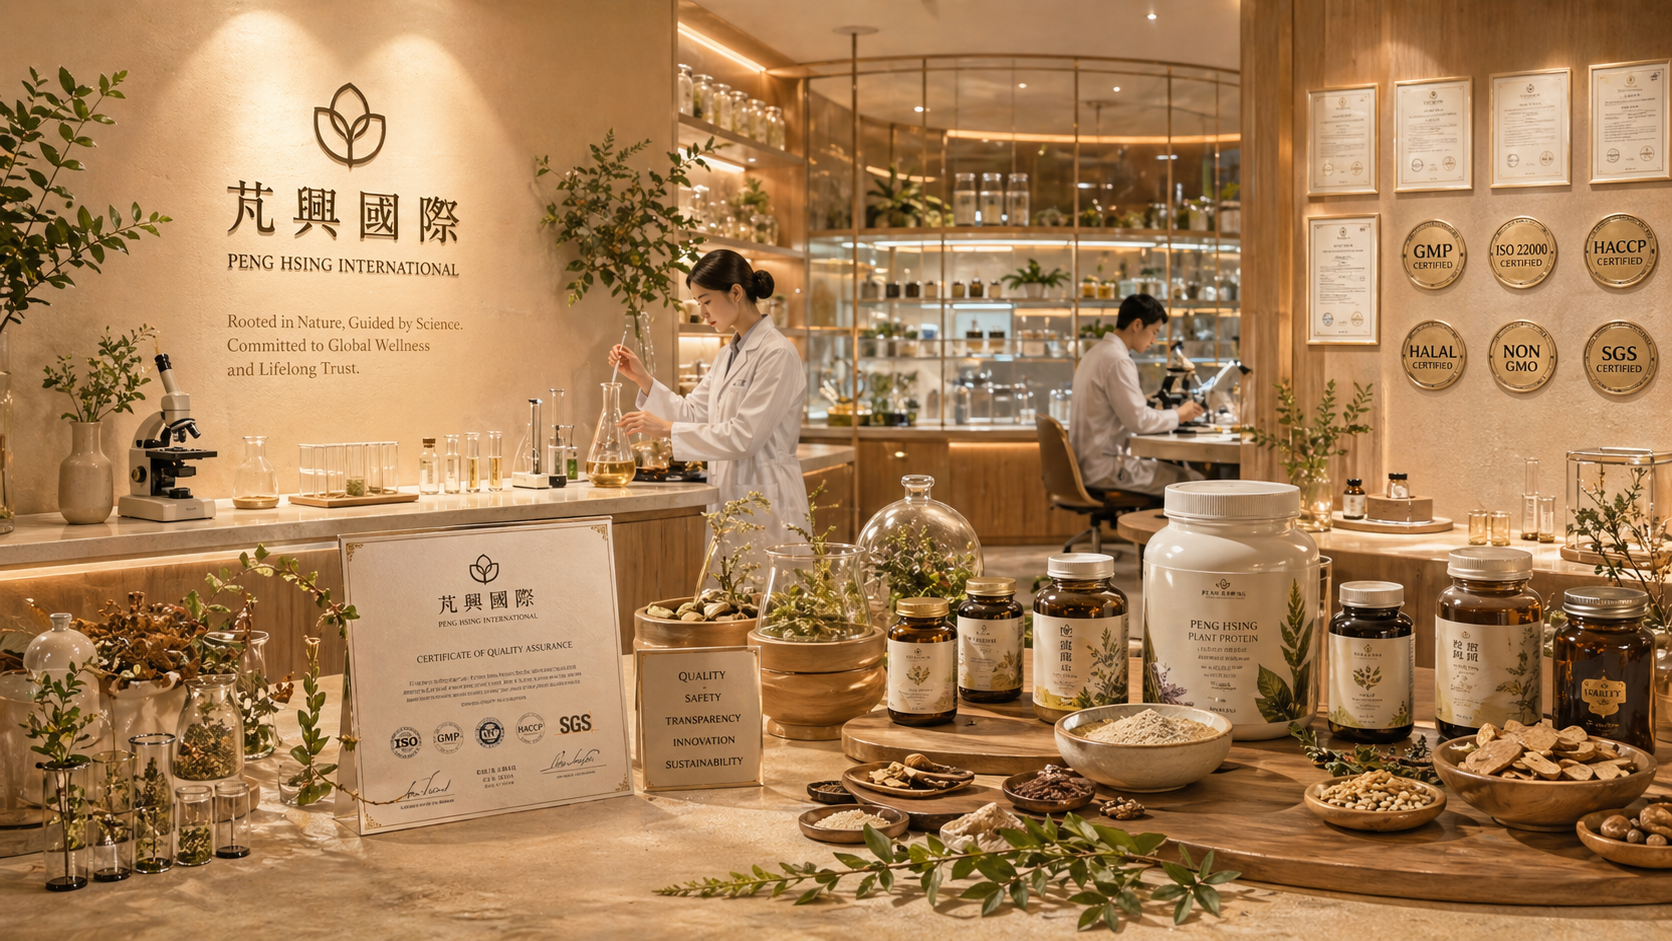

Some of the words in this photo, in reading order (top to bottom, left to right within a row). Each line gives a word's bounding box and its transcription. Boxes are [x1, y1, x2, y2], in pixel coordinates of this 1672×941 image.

[227, 179, 460, 245] 芃興國際
[1413, 243, 1453, 259] GMP
[1496, 245, 1515, 257] ISO
[1516, 243, 1548, 256] 22000
[1593, 239, 1647, 255] HACCP
[227, 253, 274, 271] PENG
[280, 255, 333, 273] HSING
[338, 258, 460, 277] INTERNATIONAL
[1413, 261, 1453, 270] CERTIFIED
[1500, 258, 1542, 268] CERTIFIED
[1596, 256, 1643, 266] CERTIFIED
[227, 314, 277, 329] Rooted
[281, 314, 294, 329] in
[297, 315, 346, 332] Nature,
[348, 315, 395, 330] Guided
[399, 316, 413, 333] by
[416, 317, 464, 331] Science.
[227, 338, 307, 353] Committed
[311, 340, 324, 353] to
[328, 338, 371, 352] Global
[375, 338, 430, 352] Wellness
[1503, 344, 1541, 359] NON
[1409, 345, 1457, 359] HALAL
[1601, 345, 1637, 362] SGS
[227, 362, 254, 376] and
[259, 362, 317, 378] Lifelong
[321, 362, 360, 376] Trust.
[1412, 361, 1453, 370] CERTIFIED
[1506, 360, 1538, 372] GMO
[1596, 364, 1642, 373] CERTIFIED
[438, 588, 535, 615] 芃興國際
[483, 613, 538, 624] INTERNATIONAL
[1190, 620, 1220, 630] PENG
[1222, 621, 1258, 631] HSING
[1188, 632, 1217, 642] PLANT
[1220, 634, 1258, 643] PROTEIN
[416, 651, 471, 664] CERTIFICATE
[473, 649, 486, 658] OF
[487, 646, 524, 658] QUALITY
[525, 641, 573, 653] ASSURANCE
[678, 671, 726, 683] QUALITY
[685, 693, 722, 703] SAFETY
[559, 713, 591, 734] SGS
[665, 714, 741, 726] TRANSPARENCY
[517, 723, 544, 734] HACCP
[395, 736, 418, 748] ISO
[437, 732, 460, 743] GMP
[673, 736, 735, 747] INNOVATION
[666, 757, 743, 769] SUSTAINABILITY
